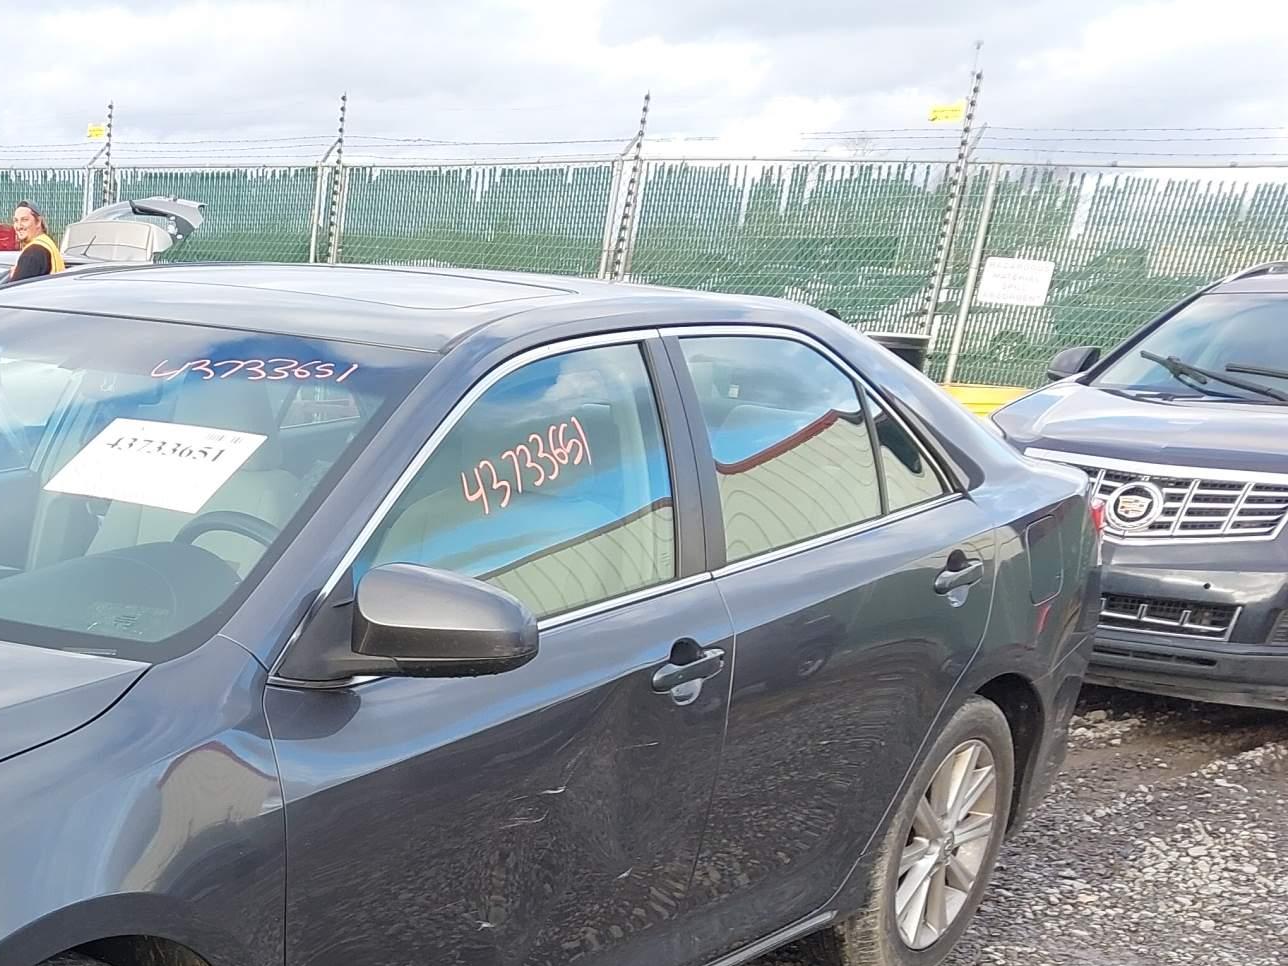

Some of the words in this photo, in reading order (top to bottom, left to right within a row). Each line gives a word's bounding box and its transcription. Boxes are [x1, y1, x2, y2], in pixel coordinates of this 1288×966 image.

[150, 358, 359, 383] 43733651
[106, 435, 226, 463] 43733651
[461, 415, 592, 515] 43733651
